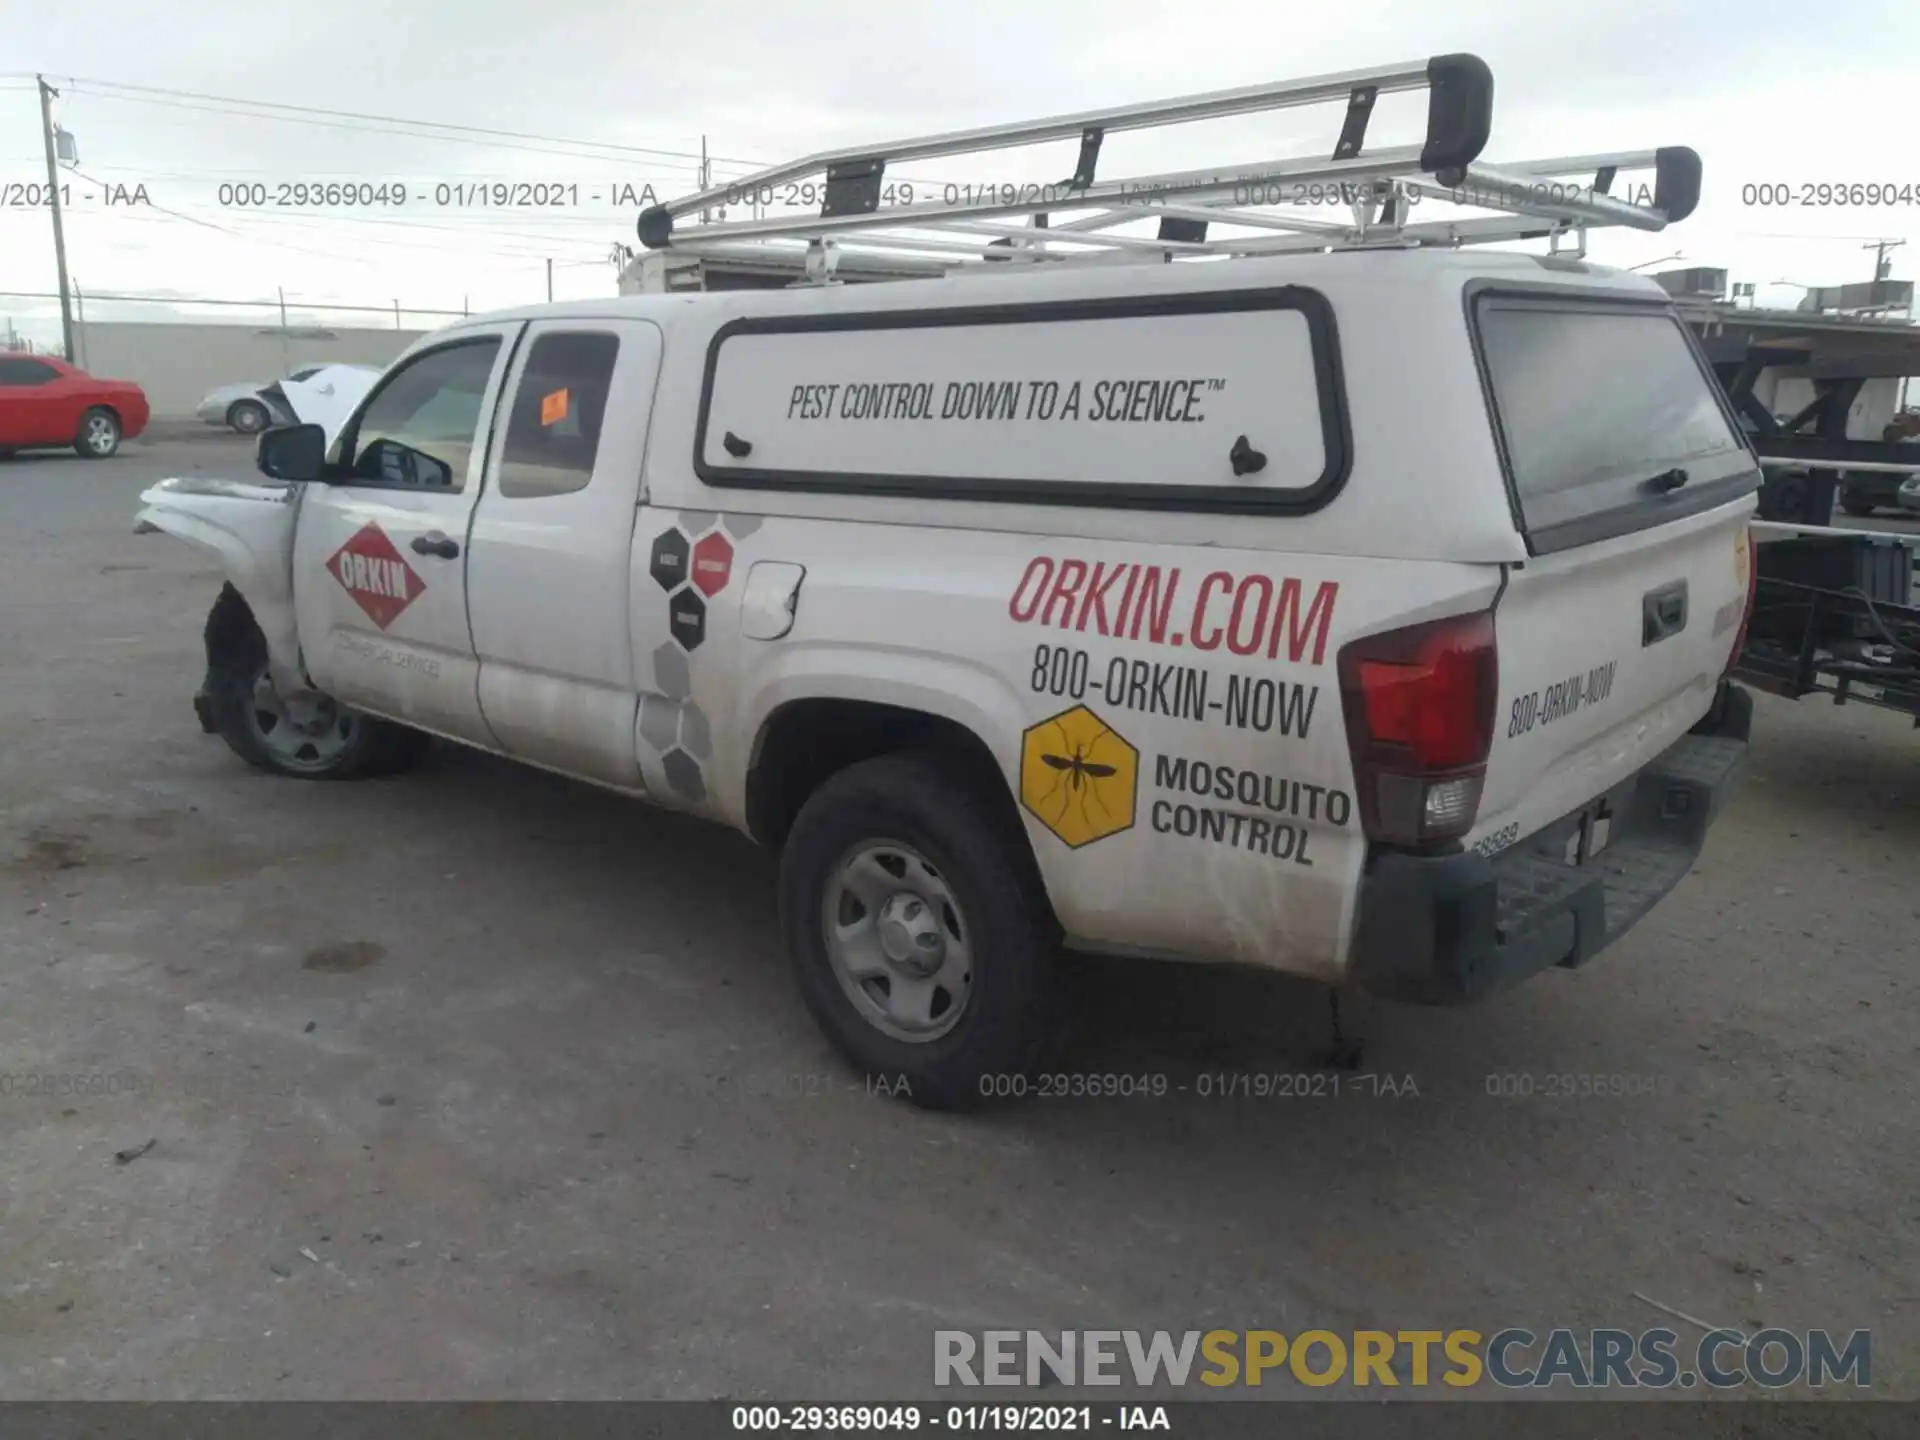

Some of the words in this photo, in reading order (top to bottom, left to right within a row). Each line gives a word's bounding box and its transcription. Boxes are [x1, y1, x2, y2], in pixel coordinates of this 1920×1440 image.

[788, 384, 840, 420] PEST
[840, 382, 934, 420] CONTROL
[941, 381, 1022, 420] DOWN
[1026, 381, 1059, 420] TO
[1059, 381, 1081, 421] A
[339, 550, 408, 600] ORKIN
[1009, 556, 1339, 666] ORKIN.COM
[1031, 644, 1319, 739] 800-ORKIN-NOW
[1508, 659, 1617, 739] 800-ORKIN-NOW
[1155, 754, 1351, 827] MOSQUITO
[1152, 800, 1313, 866] CONTROL
